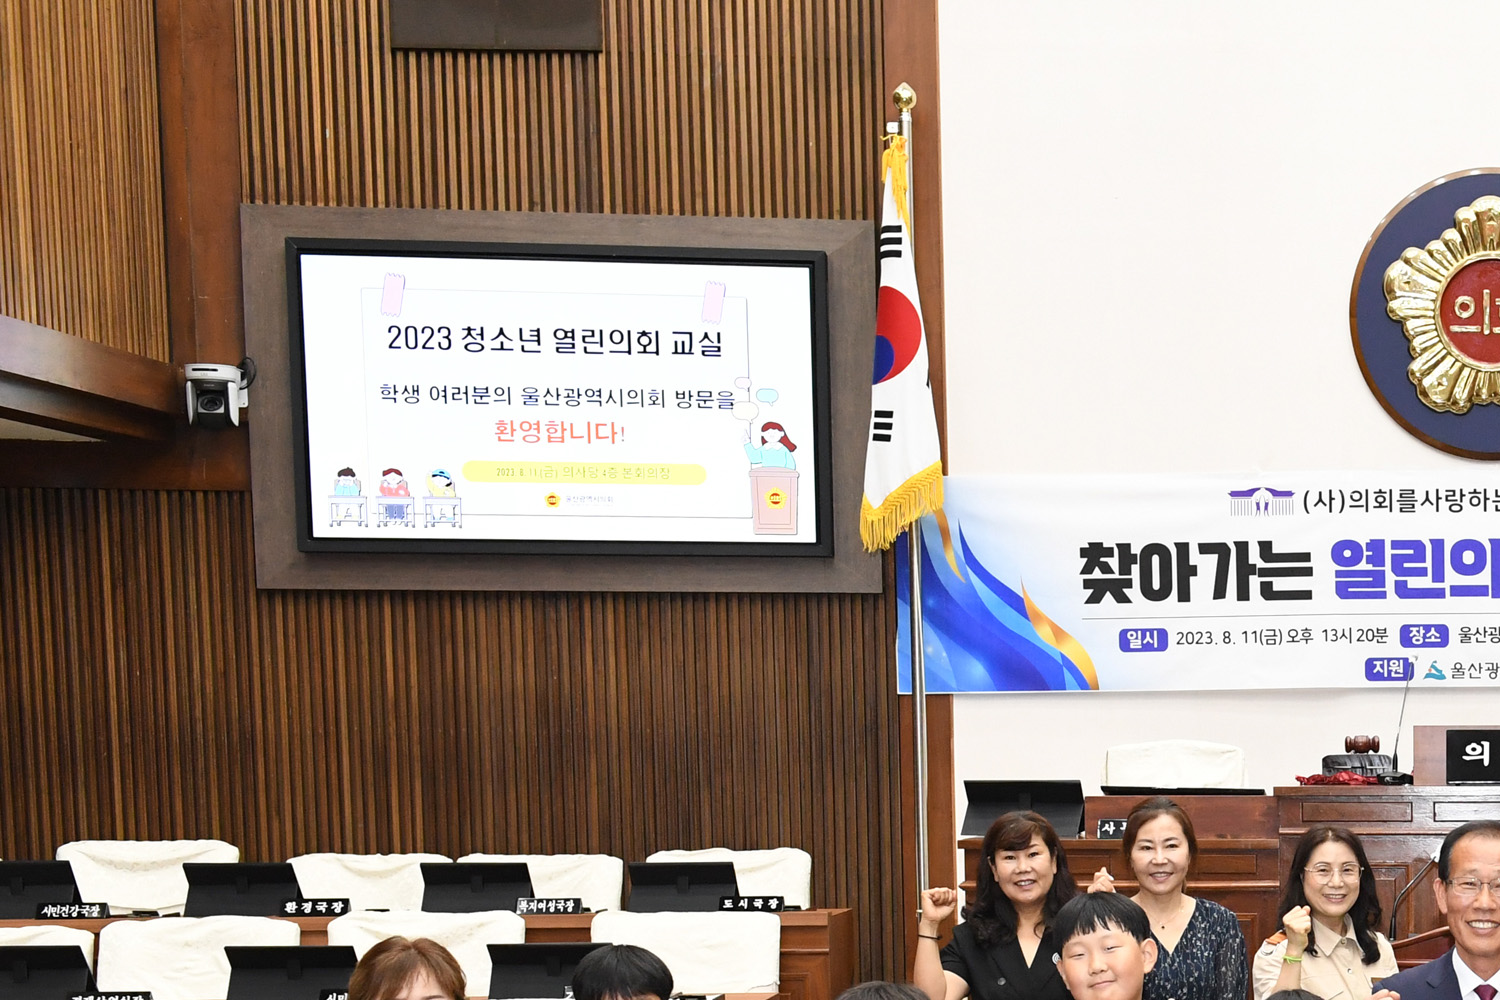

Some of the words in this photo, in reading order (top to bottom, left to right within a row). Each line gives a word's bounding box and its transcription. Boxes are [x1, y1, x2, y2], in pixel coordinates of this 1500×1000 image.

[388, 325, 452, 350] 2023
[462, 326, 541, 353] 청소년
[553, 328, 659, 356] 열린의회
[672, 331, 721, 357] 교실
[380, 384, 419, 404] 학생
[430, 385, 511, 405] 여러분의
[521, 387, 665, 408] 울산광역시의회
[676, 390, 735, 410] 방문을
[495, 420, 624, 444] 환영합니다!
[1079, 541, 1313, 604] 찾아가는
[1126, 631, 1158, 649] 일시
[1176, 631, 1217, 645] 2023.
[1223, 631, 1235, 644] 8.
[1242, 629, 1282, 645] 11(금)
[1286, 627, 1313, 644] 오후
[1322, 627, 1352, 644] 13시
[1357, 627, 1388, 643] 20분
[1408, 626, 1441, 645] 장소
[1372, 660, 1404, 679] 지원
[41, 904, 100, 917] 시민건강국장
[284, 901, 345, 914] 환경국장
[722, 898, 780, 910] 도시국장
